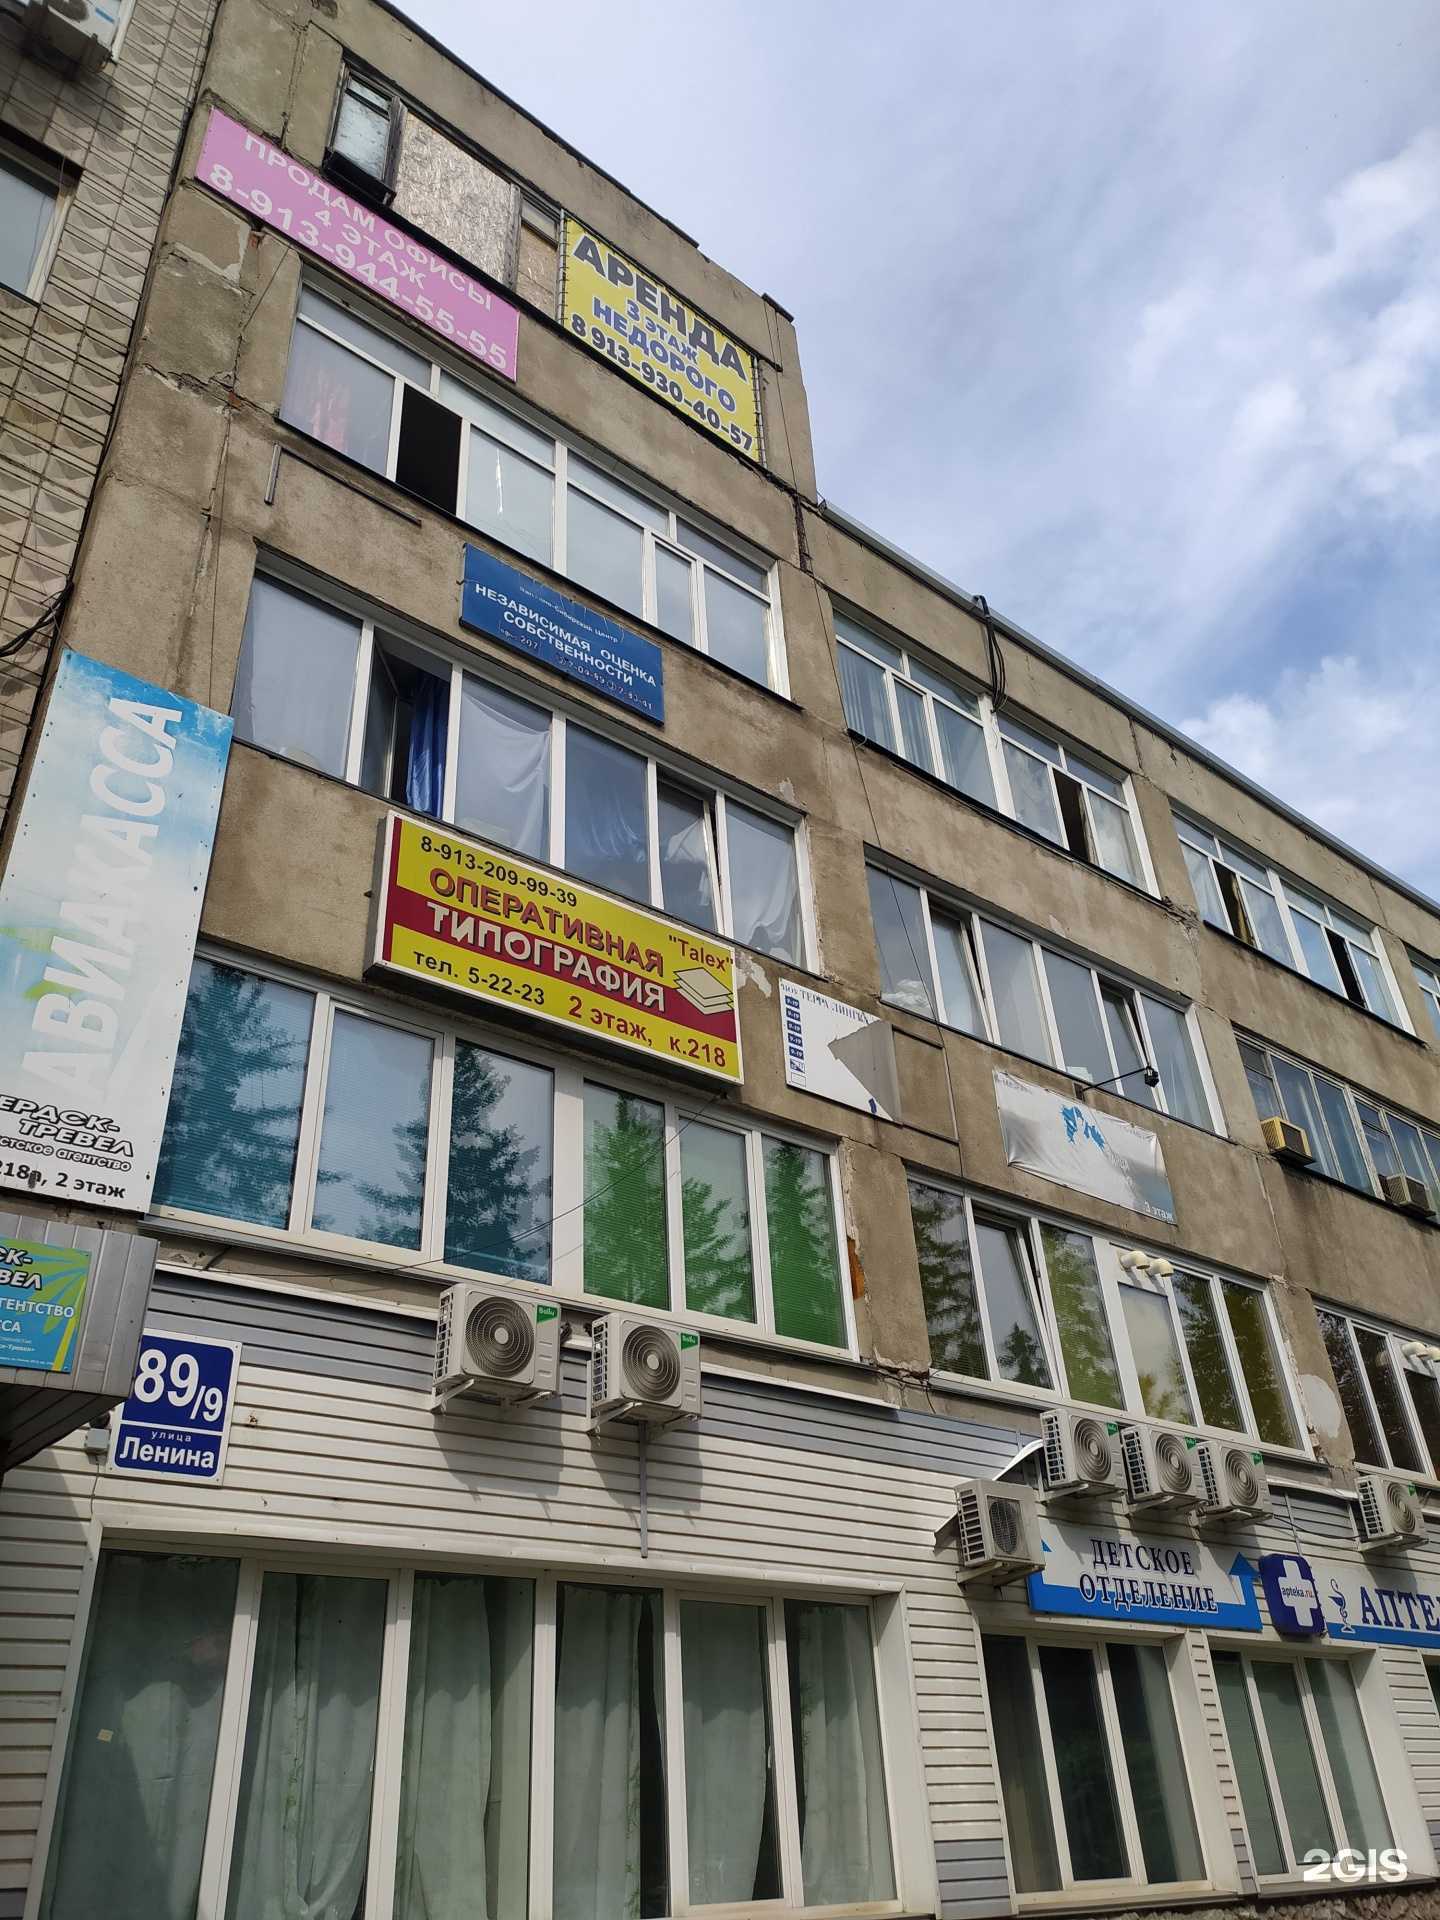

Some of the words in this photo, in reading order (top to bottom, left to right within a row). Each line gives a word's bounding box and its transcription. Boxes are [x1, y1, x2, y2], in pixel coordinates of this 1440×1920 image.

[244, 134, 376, 233] ПРОДАМ
[383, 229, 493, 312] ОФИСЫ
[314, 209, 331, 227] 4
[342, 223, 425, 290] ЭТАЖ
[209, 163, 507, 371] 8-913-944-55-55
[573, 234, 748, 382] АРЕНДА
[626, 299, 640, 321] 3
[570, 313, 587, 338] 8
[591, 326, 753, 452] 913-930-40-57
[592, 297, 736, 413] НЕДОРОГО
[475, 583, 590, 651] НЕЗАВИСИМАЯ
[600, 649, 656, 687] ОЦЕНКА
[503, 611, 633, 686] СОБСТВЕННОСТИ
[21, 697, 183, 1102] АВИАКАССА
[420, 835, 577, 907] 8-913-209-99-39
[426, 901, 665, 1013] ТИПОГРАФИЯ
[429, 867, 664, 977] ОПЕРАТИВНАЯ
[668, 934, 734, 972] "Talex"
[414, 950, 459, 979] тел.
[467, 966, 545, 1006] 5-22-23
[568, 995, 583, 1017] 2
[590, 1006, 653, 1047] этаж,
[670, 1035, 726, 1068] к.218
[19, 1119, 134, 1158] ТРЕВЕЛ
[55, 1148, 132, 1172] агентство
[55, 1172, 69, 1188] 2
[73, 1178, 126, 1199] этаж
[134, 1349, 223, 1422] 89/9
[119, 1436, 214, 1469] Ленина
[151, 1430, 191, 1442] улица
[1079, 1573, 1218, 1613] ОТДЕЛЕНИЕ
[1089, 1538, 1194, 1576] ДЕТСКОЕ
[1281, 1586, 1313, 1598] apteka.ru
[1360, 1586, 1440, 1632] АПТЕ
